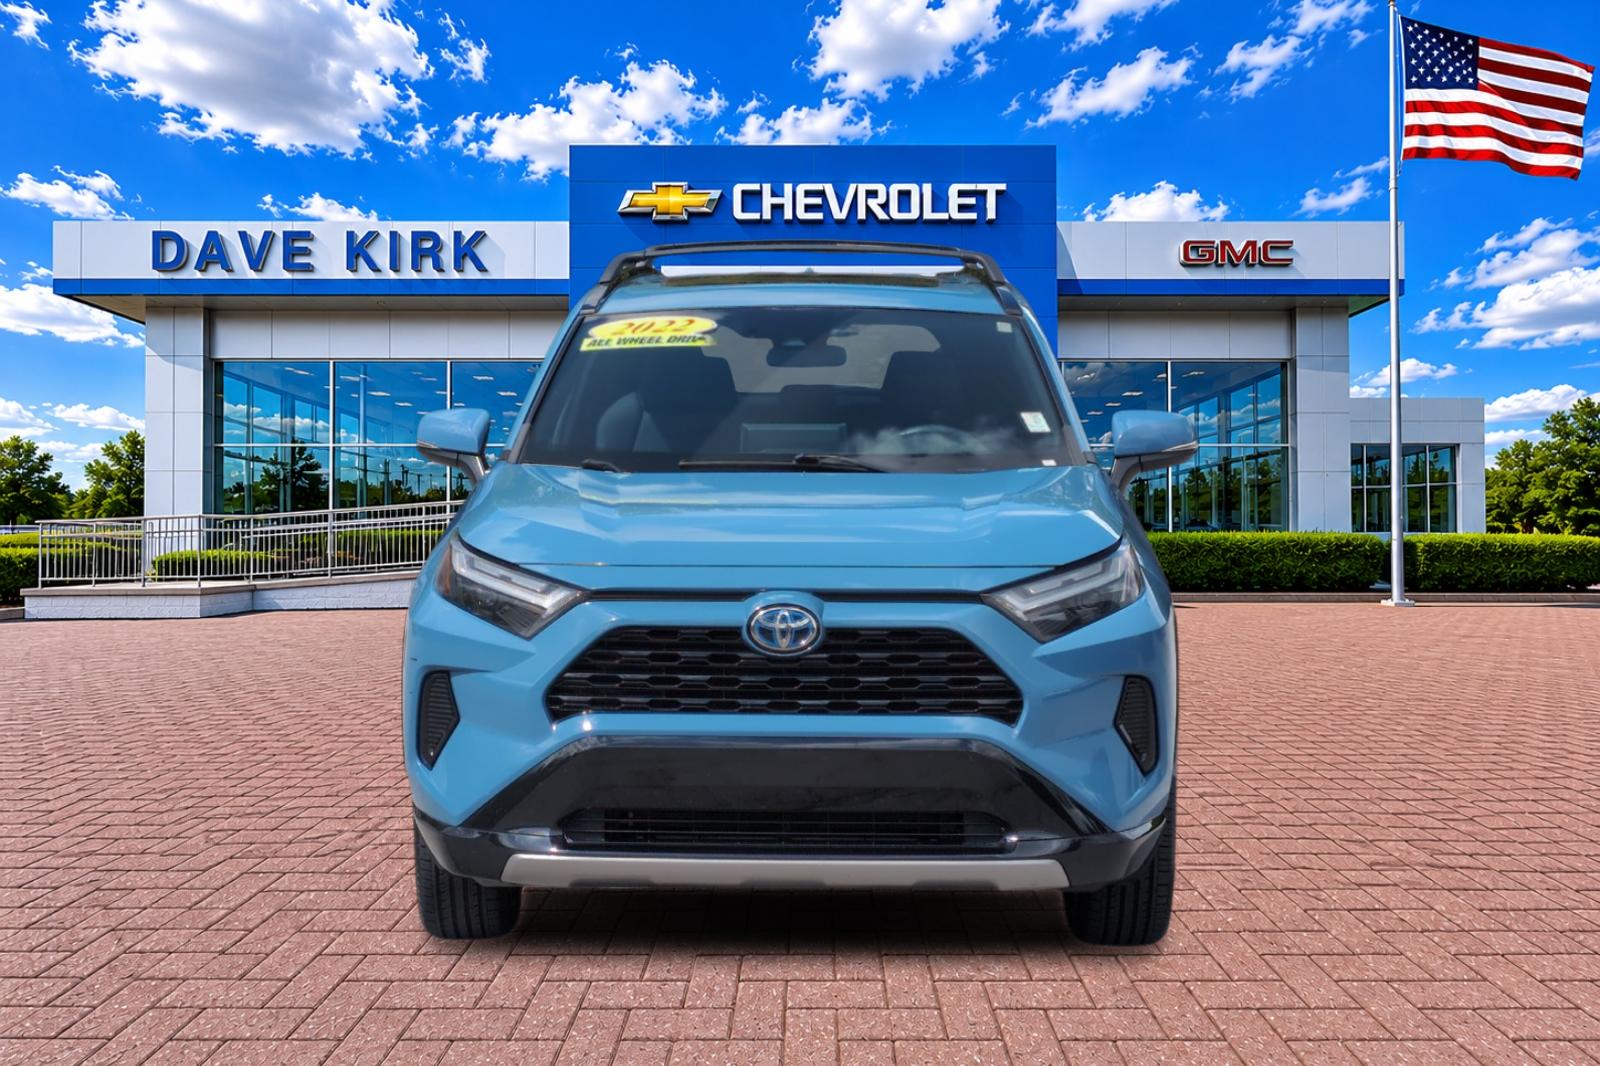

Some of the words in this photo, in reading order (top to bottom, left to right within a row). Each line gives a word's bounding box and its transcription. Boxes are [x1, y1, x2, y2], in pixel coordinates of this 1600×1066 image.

[732, 183, 1007, 222] CHEVROLET
[151, 230, 315, 273] DAVE
[346, 230, 489, 273] KIRK
[1180, 239, 1295, 267] GMC
[611, 318, 696, 335] 2022
[586, 338, 612, 348] ALL
[616, 335, 663, 345] WHEEL
